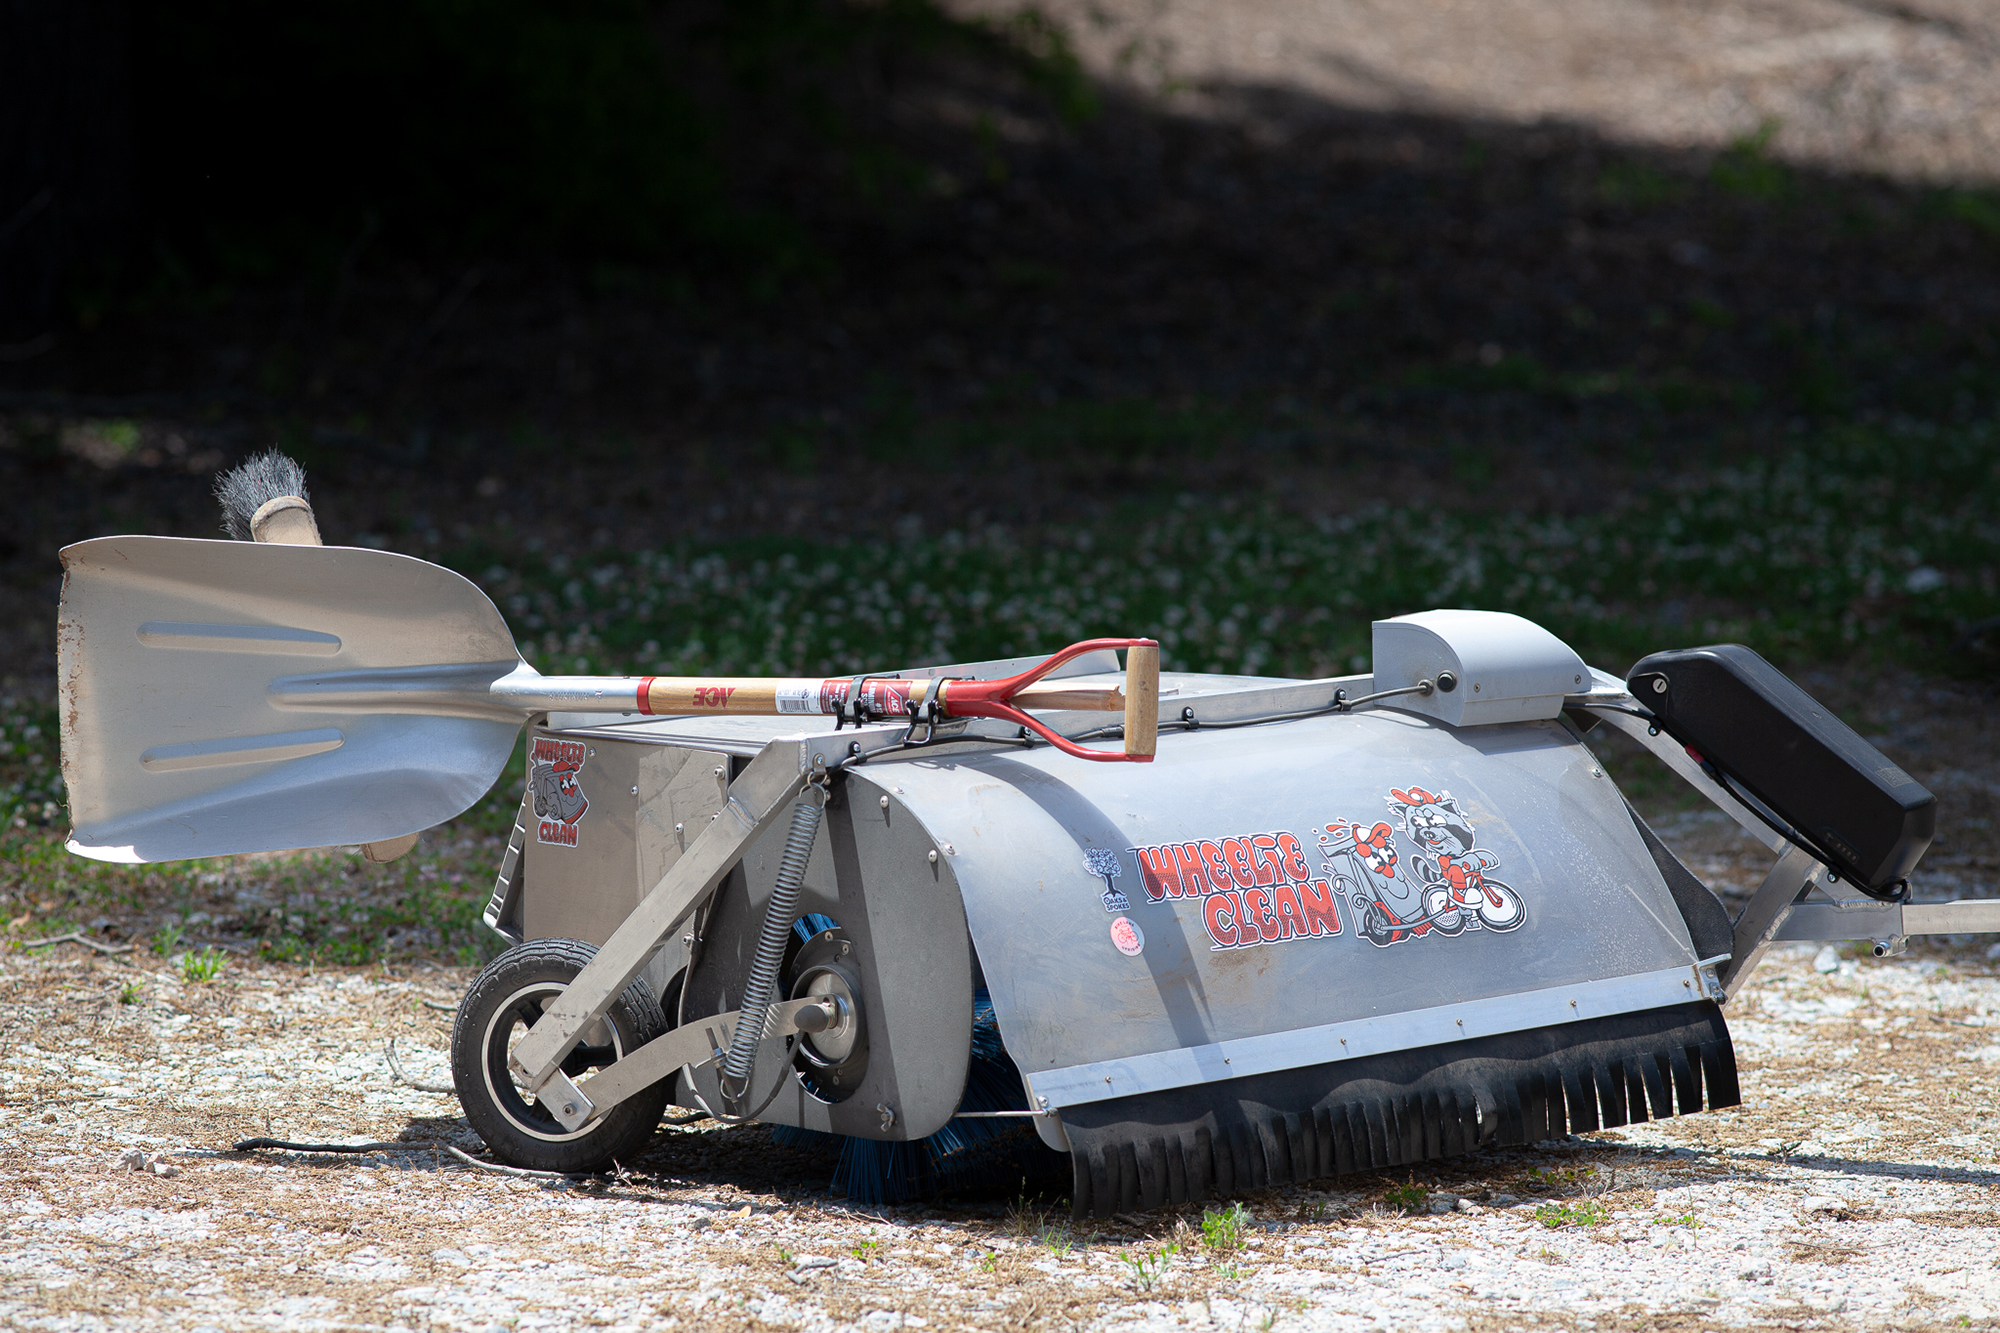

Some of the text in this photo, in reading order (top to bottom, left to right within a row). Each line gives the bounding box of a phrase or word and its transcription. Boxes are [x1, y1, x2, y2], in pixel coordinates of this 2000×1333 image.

[692, 687, 736, 709] ACE
[890, 696, 900, 713] ACE
[539, 822, 578, 846] CLEAN
[1103, 897, 1122, 905] OAKS
[1106, 903, 1130, 911] SPOKES
[1202, 880, 1342, 946] CLEAN
